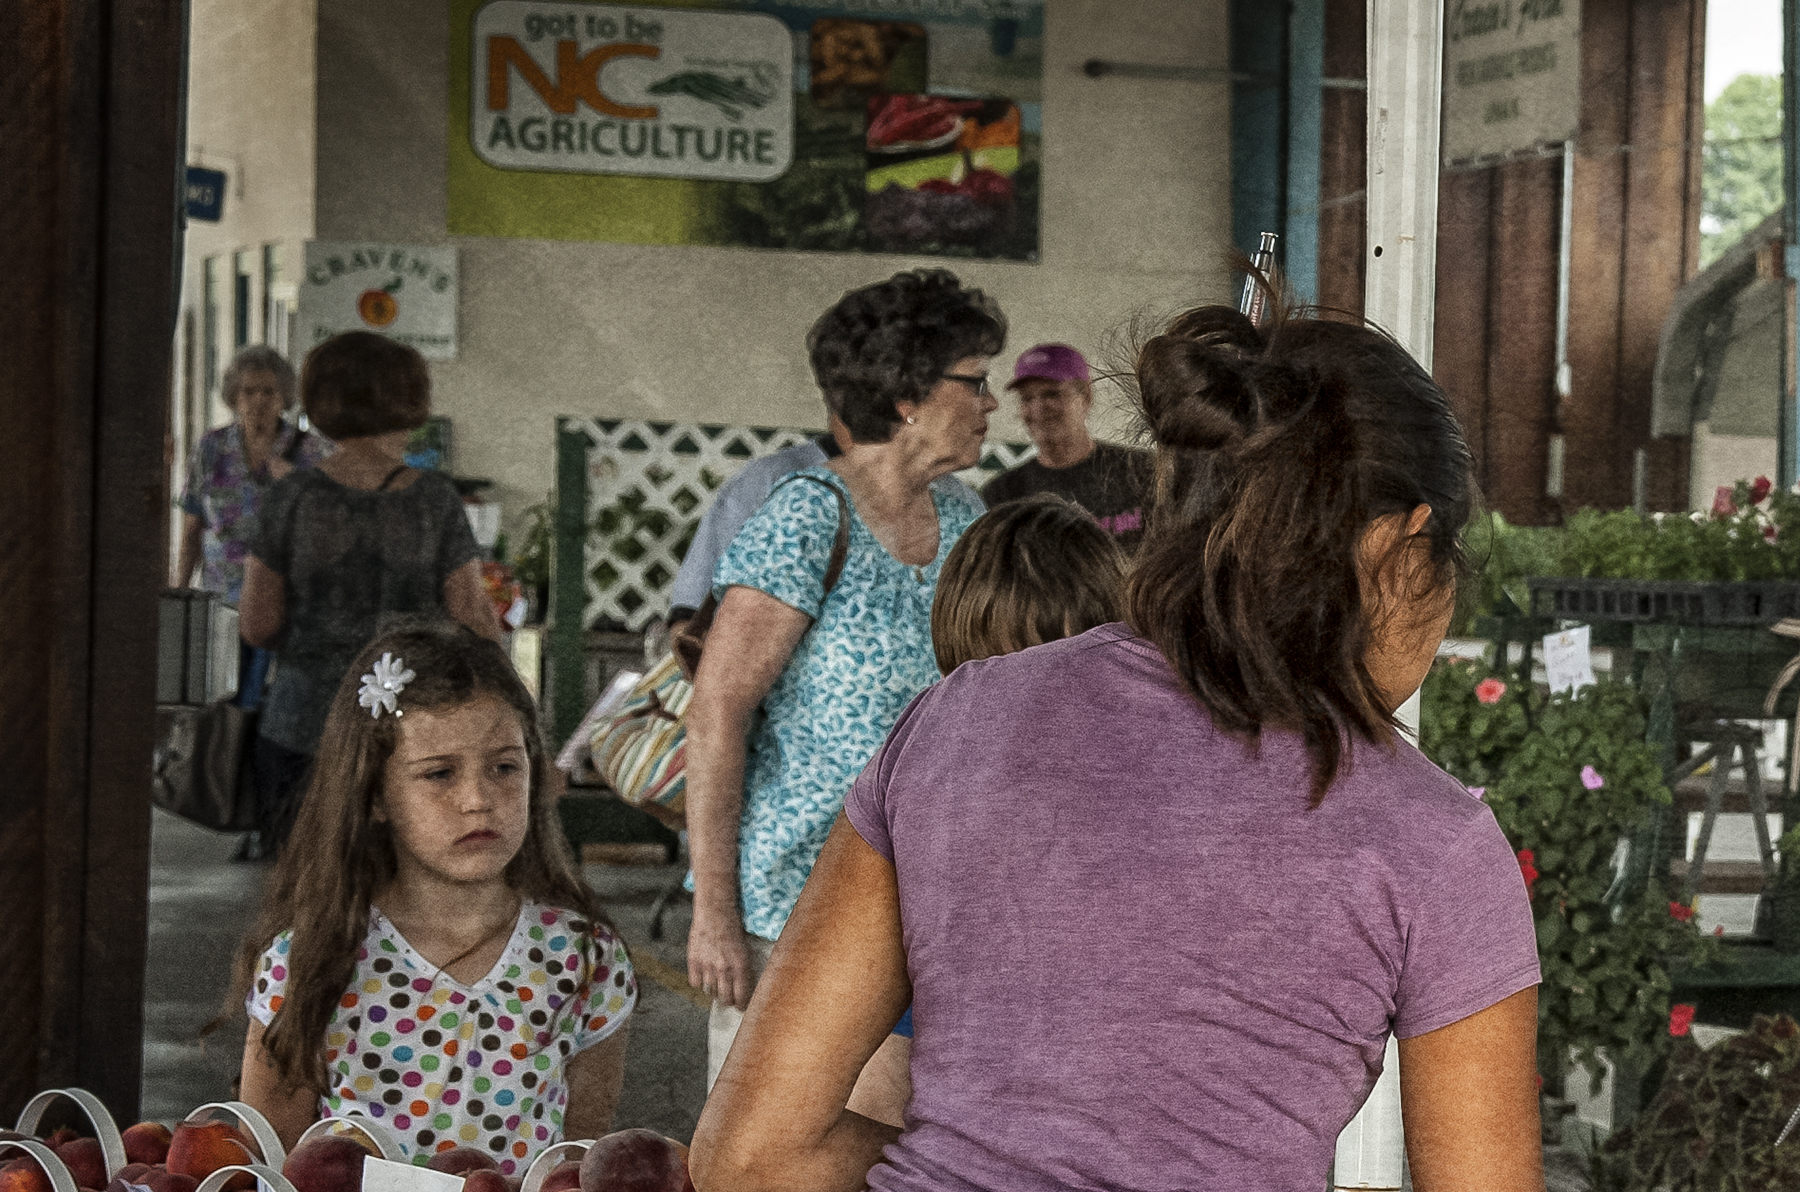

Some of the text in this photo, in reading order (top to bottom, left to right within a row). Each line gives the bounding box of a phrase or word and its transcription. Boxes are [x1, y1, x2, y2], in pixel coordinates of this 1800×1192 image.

[525, 12, 664, 42] got to be
[488, 36, 660, 118] NC
[488, 115, 776, 165] AGRICULTURE
